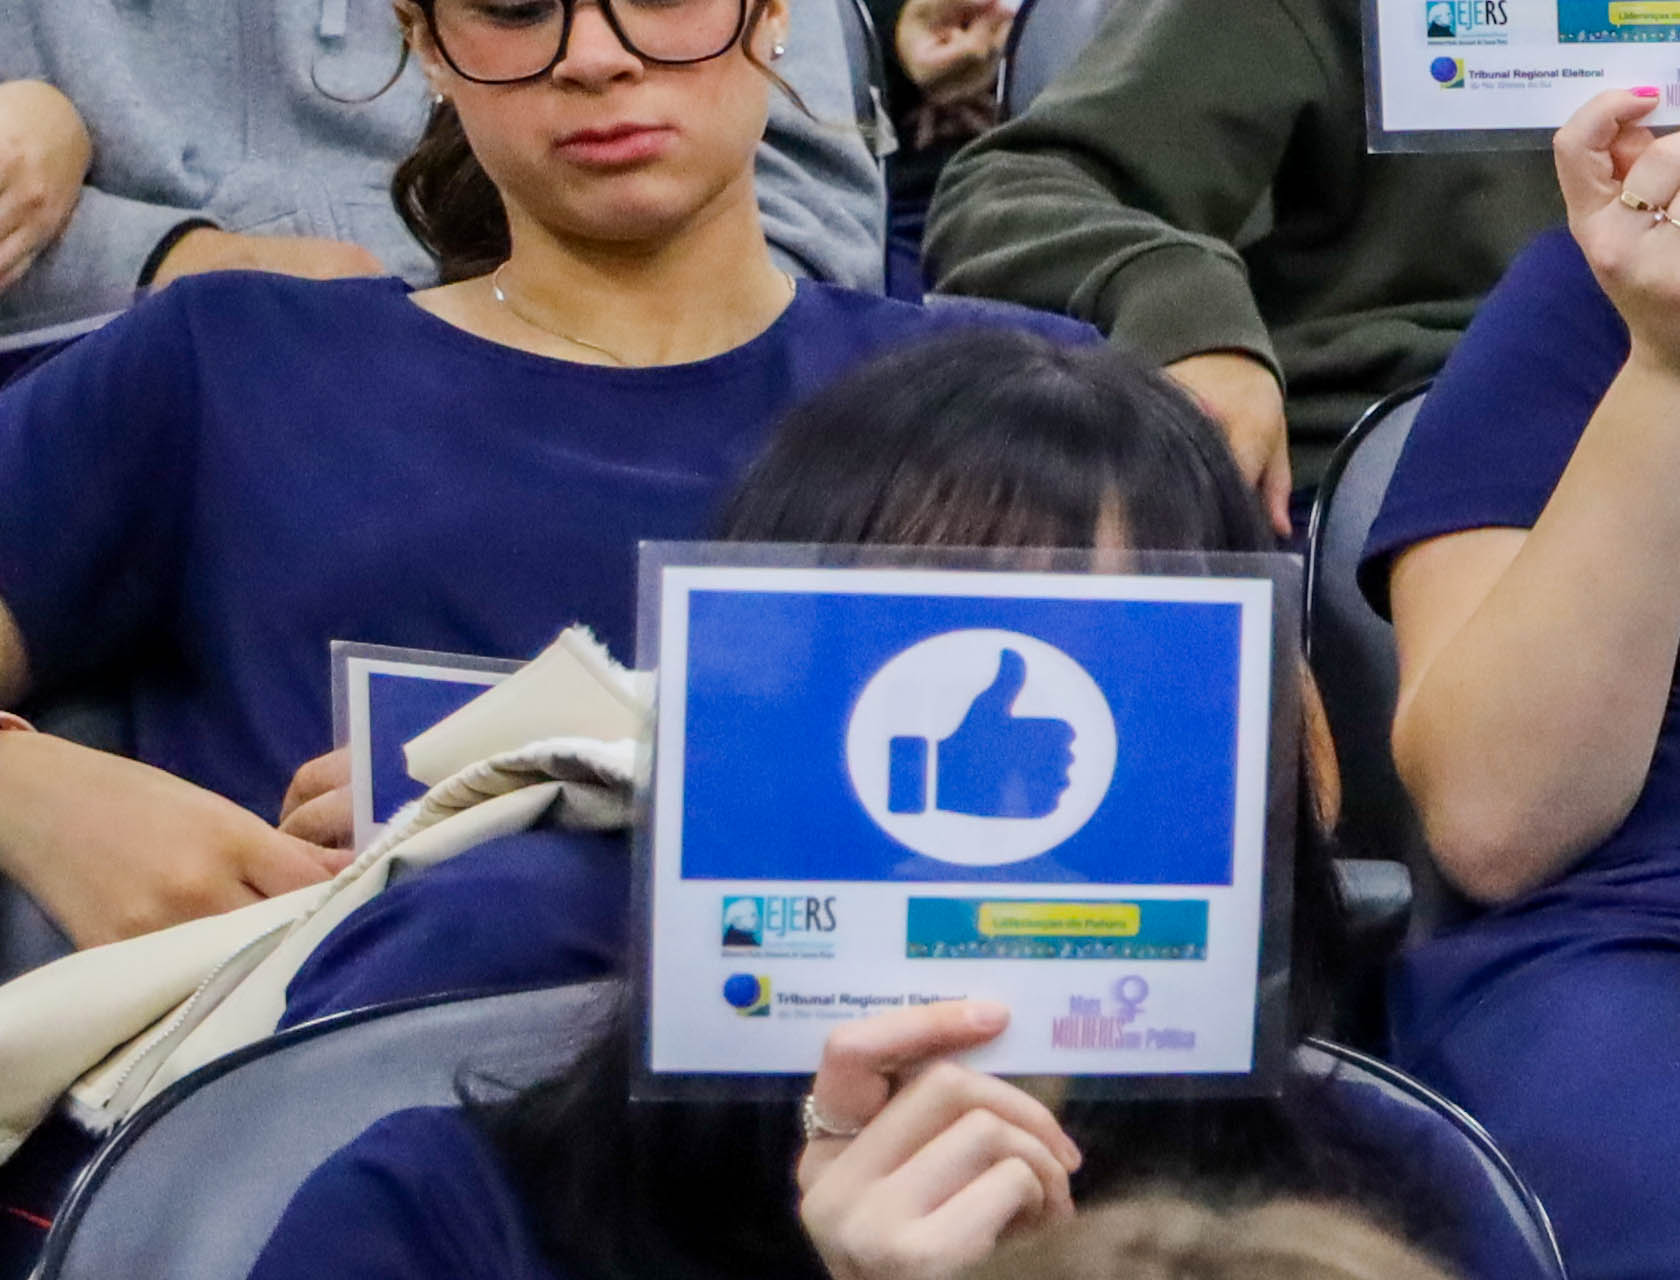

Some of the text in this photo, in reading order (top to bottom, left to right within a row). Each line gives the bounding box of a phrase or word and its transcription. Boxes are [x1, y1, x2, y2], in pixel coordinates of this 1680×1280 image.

[1456, 0, 1507, 27] EJERS
[1469, 67, 1604, 80] Tribunal Regional Eleitoral
[765, 896, 836, 937] EJERS
[776, 993, 834, 1006] Tribunal
[839, 993, 904, 1008] Regional
